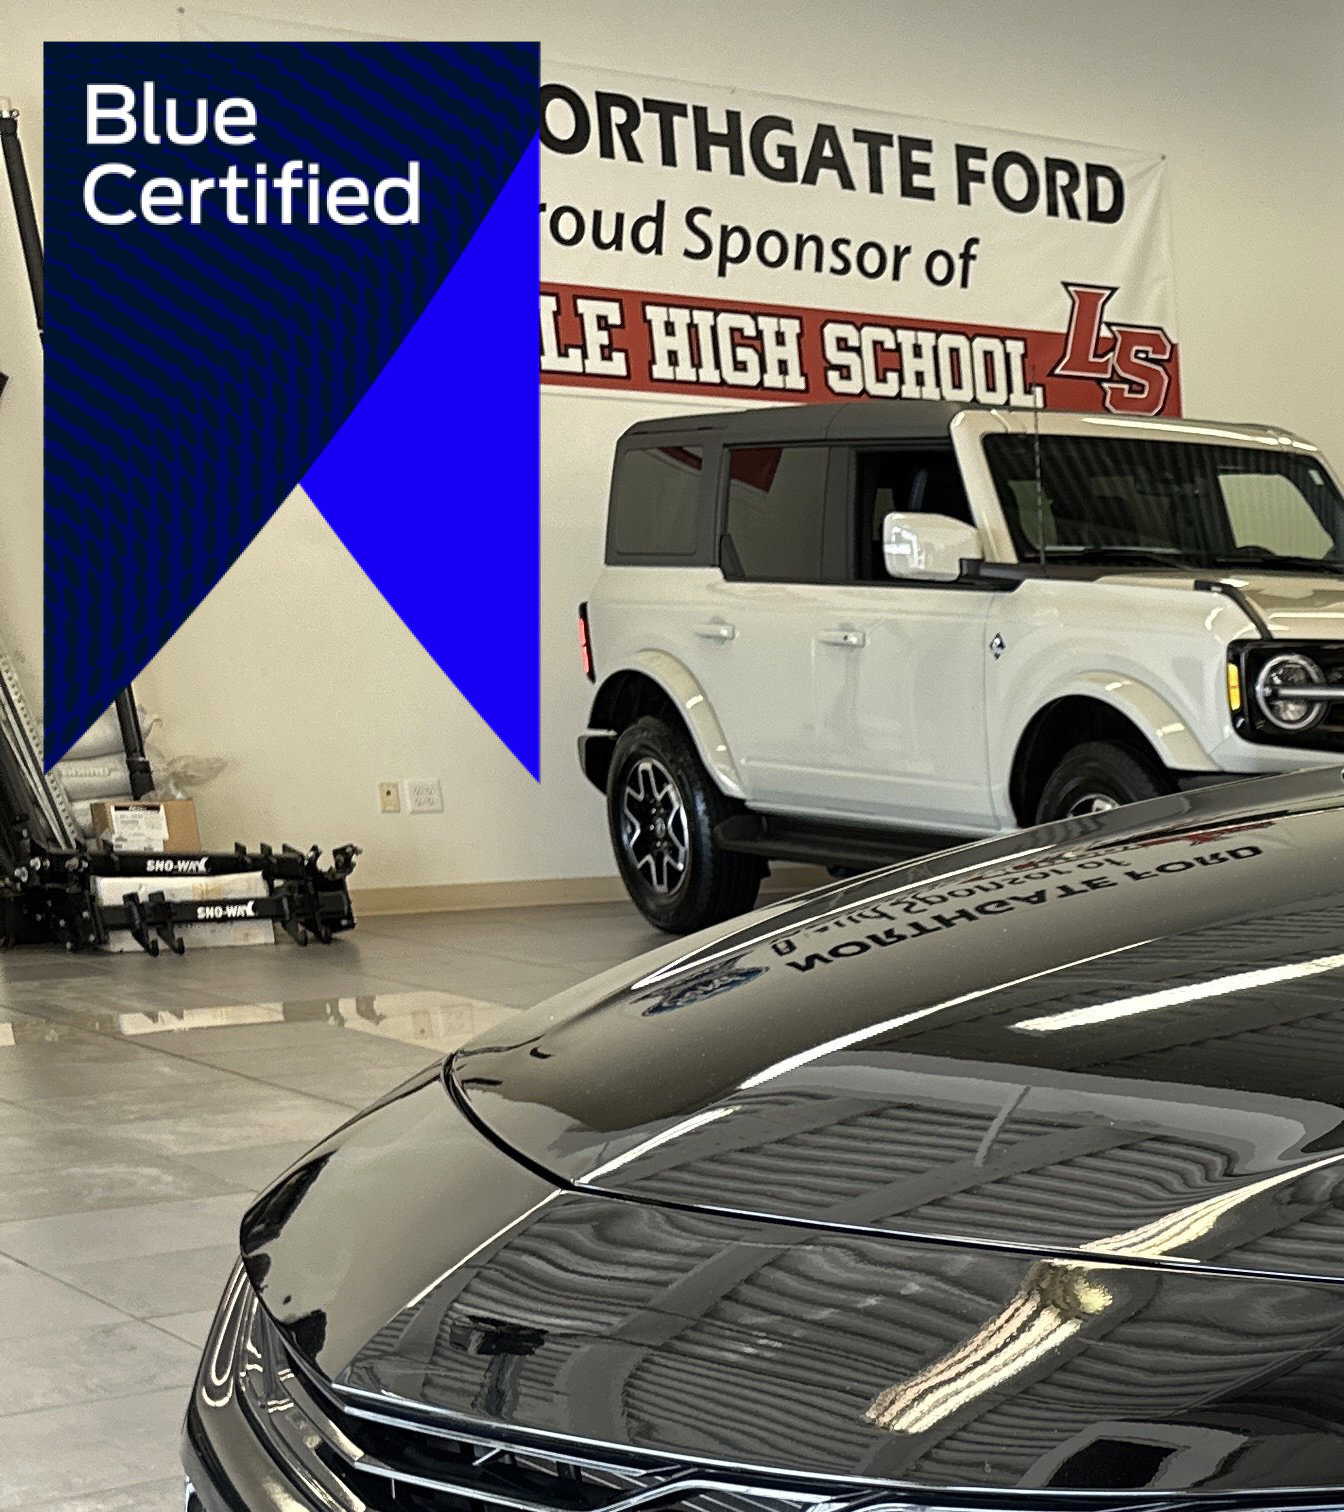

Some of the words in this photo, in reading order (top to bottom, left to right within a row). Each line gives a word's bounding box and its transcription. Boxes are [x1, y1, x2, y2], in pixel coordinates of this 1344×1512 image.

[539, 83, 936, 201] ORTHGATE
[954, 144, 1125, 224] FORD
[539, 199, 666, 256] oud
[684, 207, 911, 281] Sponsor
[926, 237, 980, 288] of
[645, 304, 806, 393] HIGH
[823, 320, 1045, 409] SCHOOL
